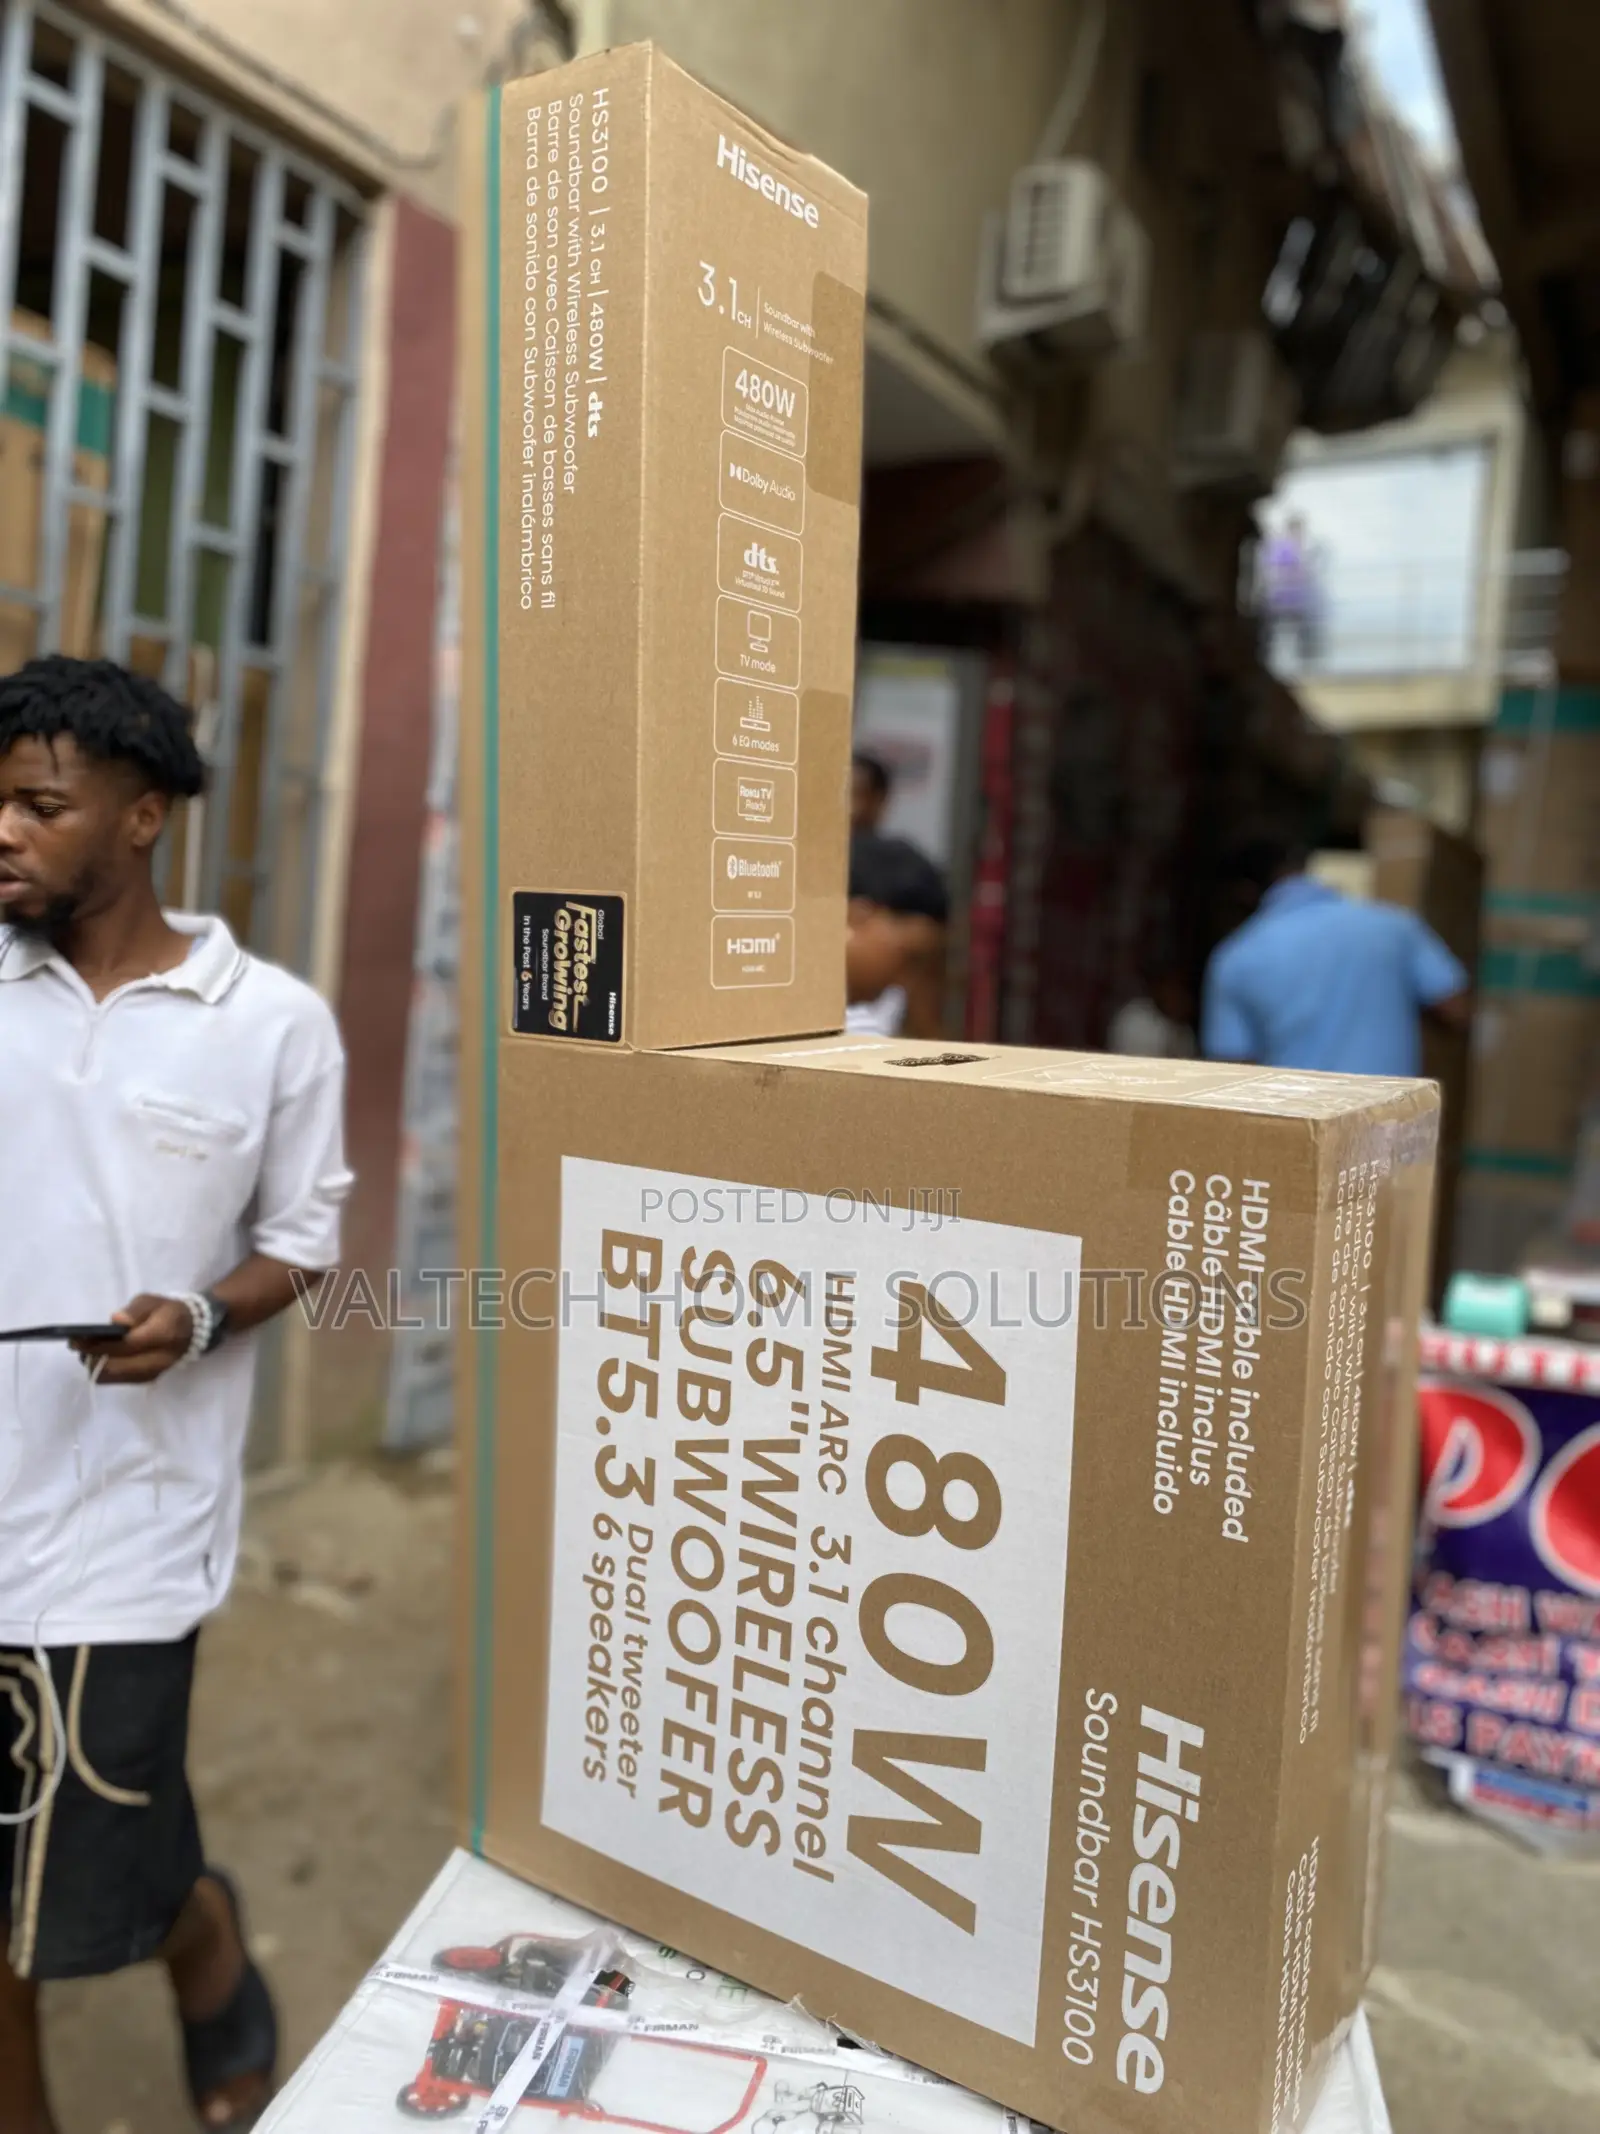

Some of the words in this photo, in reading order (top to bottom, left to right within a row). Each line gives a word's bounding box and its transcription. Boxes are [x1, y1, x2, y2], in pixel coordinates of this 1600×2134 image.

[527, 106, 541, 170] Barra
[548, 100, 562, 162] Barre
[569, 92, 584, 213] Soundbar
[593, 88, 609, 193] HS3100
[527, 176, 541, 207] de
[548, 169, 562, 200] de
[716, 134, 819, 229] Hisense
[526, 212, 540, 291] sonido
[548, 206, 558, 248] son
[568, 217, 583, 268] with
[591, 223, 605, 252] 3.1
[547, 255, 558, 311] avec
[591, 259, 601, 284] CH
[525, 297, 536, 341] con
[566, 272, 581, 365] Wireless
[589, 302, 604, 371] 480W
[545, 317, 560, 408] Caisson
[735, 368, 796, 418] 480W
[523, 346, 538, 467] Subwoofer
[544, 415, 558, 443] de
[564, 371, 579, 494] Subwoofer
[589, 391, 603, 438] dts
[542, 449, 558, 528] basses
[743, 467, 769, 495] Dolby
[769, 480, 796, 501] Audio
[521, 473, 537, 610] inalámbrico
[542, 533, 553, 585] sans
[542, 589, 556, 608] fil
[741, 653, 751, 667] TV
[751, 658, 776, 674] mode
[733, 734, 738, 746] 6
[740, 735, 750, 747] EQ
[751, 739, 779, 753] modes
[760, 788, 772, 800] TV
[523, 928, 531, 944] the
[523, 945, 532, 968] Past
[524, 915, 532, 925] In
[542, 928, 550, 973] Soundbar
[520, 970, 533, 982] 6
[523, 982, 532, 1011] Years
[567, 901, 597, 1033] Fastest
[609, 992, 617, 1036] Hisense
[1166, 1169, 1196, 1271] Cable
[1202, 1173, 1233, 1277] Câble
[1238, 1177, 1271, 1273] HDMI
[1335, 1170, 1347, 1241] Barra
[1345, 1166, 1357, 1235] Barre
[1352, 1161, 1368, 1290] Soundbar
[1364, 1159, 1380, 1269] HS3100
[1332, 1249, 1341, 1284] de
[1343, 1242, 1351, 1277] de
[823, 1272, 856, 1393] HDMI
[1161, 1279, 1190, 1371] HDMI
[1196, 1284, 1226, 1378] HDMI
[1232, 1280, 1262, 1379] cable
[1326, 1290, 1337, 1380] sonido
[1339, 1283, 1348, 1331] son
[1347, 1295, 1357, 1349] with
[594, 1228, 663, 1507] BT5.3
[1334, 1337, 1344, 1401] avec
[1190, 1383, 1224, 1486] inclus
[1321, 1387, 1330, 1438] con
[1340, 1353, 1354, 1458] Wireless
[818, 1400, 849, 1496] ARC
[1154, 1376, 1189, 1515] incluido
[1221, 1386, 1261, 1544] included
[592, 1512, 624, 1542] 6
[658, 1245, 736, 1829] SUBWOOFER
[808, 1525, 852, 1604] 3.1
[625, 1522, 655, 1625] Dual
[846, 1278, 1006, 1937] 480W
[583, 1552, 618, 1783] speakers
[724, 1438, 801, 1856] WIRELESS
[617, 1633, 648, 1799] tweeter
[793, 1616, 847, 1883] channel
[1072, 1687, 1118, 1908] Soundbar
[1115, 1703, 1205, 2095] Hisense
[1061, 1911, 1103, 2067] HS3100
[533, 2022, 551, 2060] FIRMAN
[644, 2023, 699, 2032] FIRMAN
